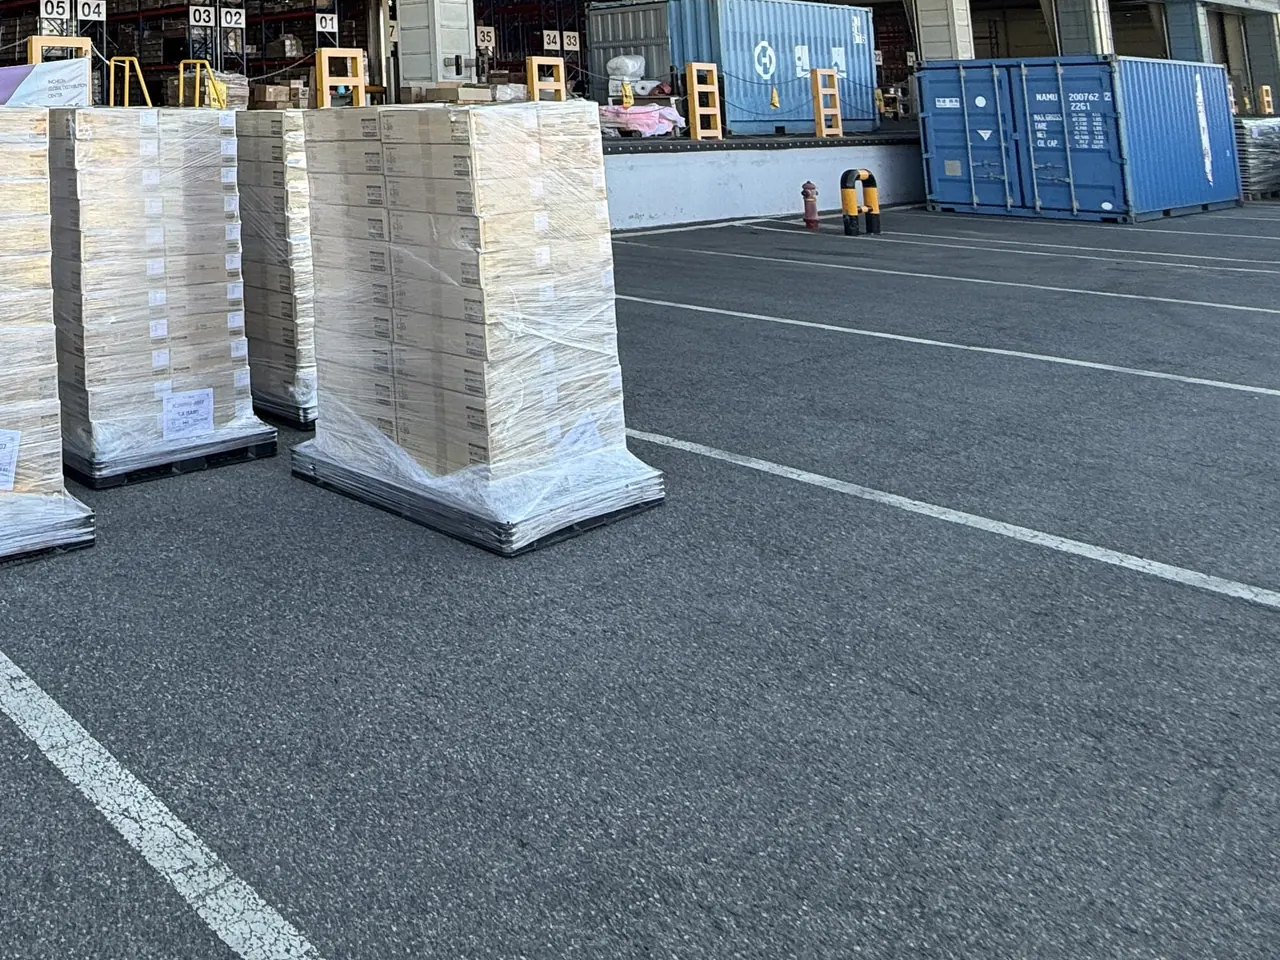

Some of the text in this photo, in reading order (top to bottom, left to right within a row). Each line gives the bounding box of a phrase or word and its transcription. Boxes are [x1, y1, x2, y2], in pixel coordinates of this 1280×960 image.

[44, 0, 66, 16] 05
[81, 2, 102, 18] 04
[193, 9, 212, 24] 03
[224, 10, 242, 25] 02
[320, 16, 335, 30] 01
[480, 30, 492, 43] 35
[546, 33, 557, 46] 34
[566, 34, 577, 47] 33
[1036, 93, 1058, 101] NAMU
[1068, 92, 1100, 101] 200762
